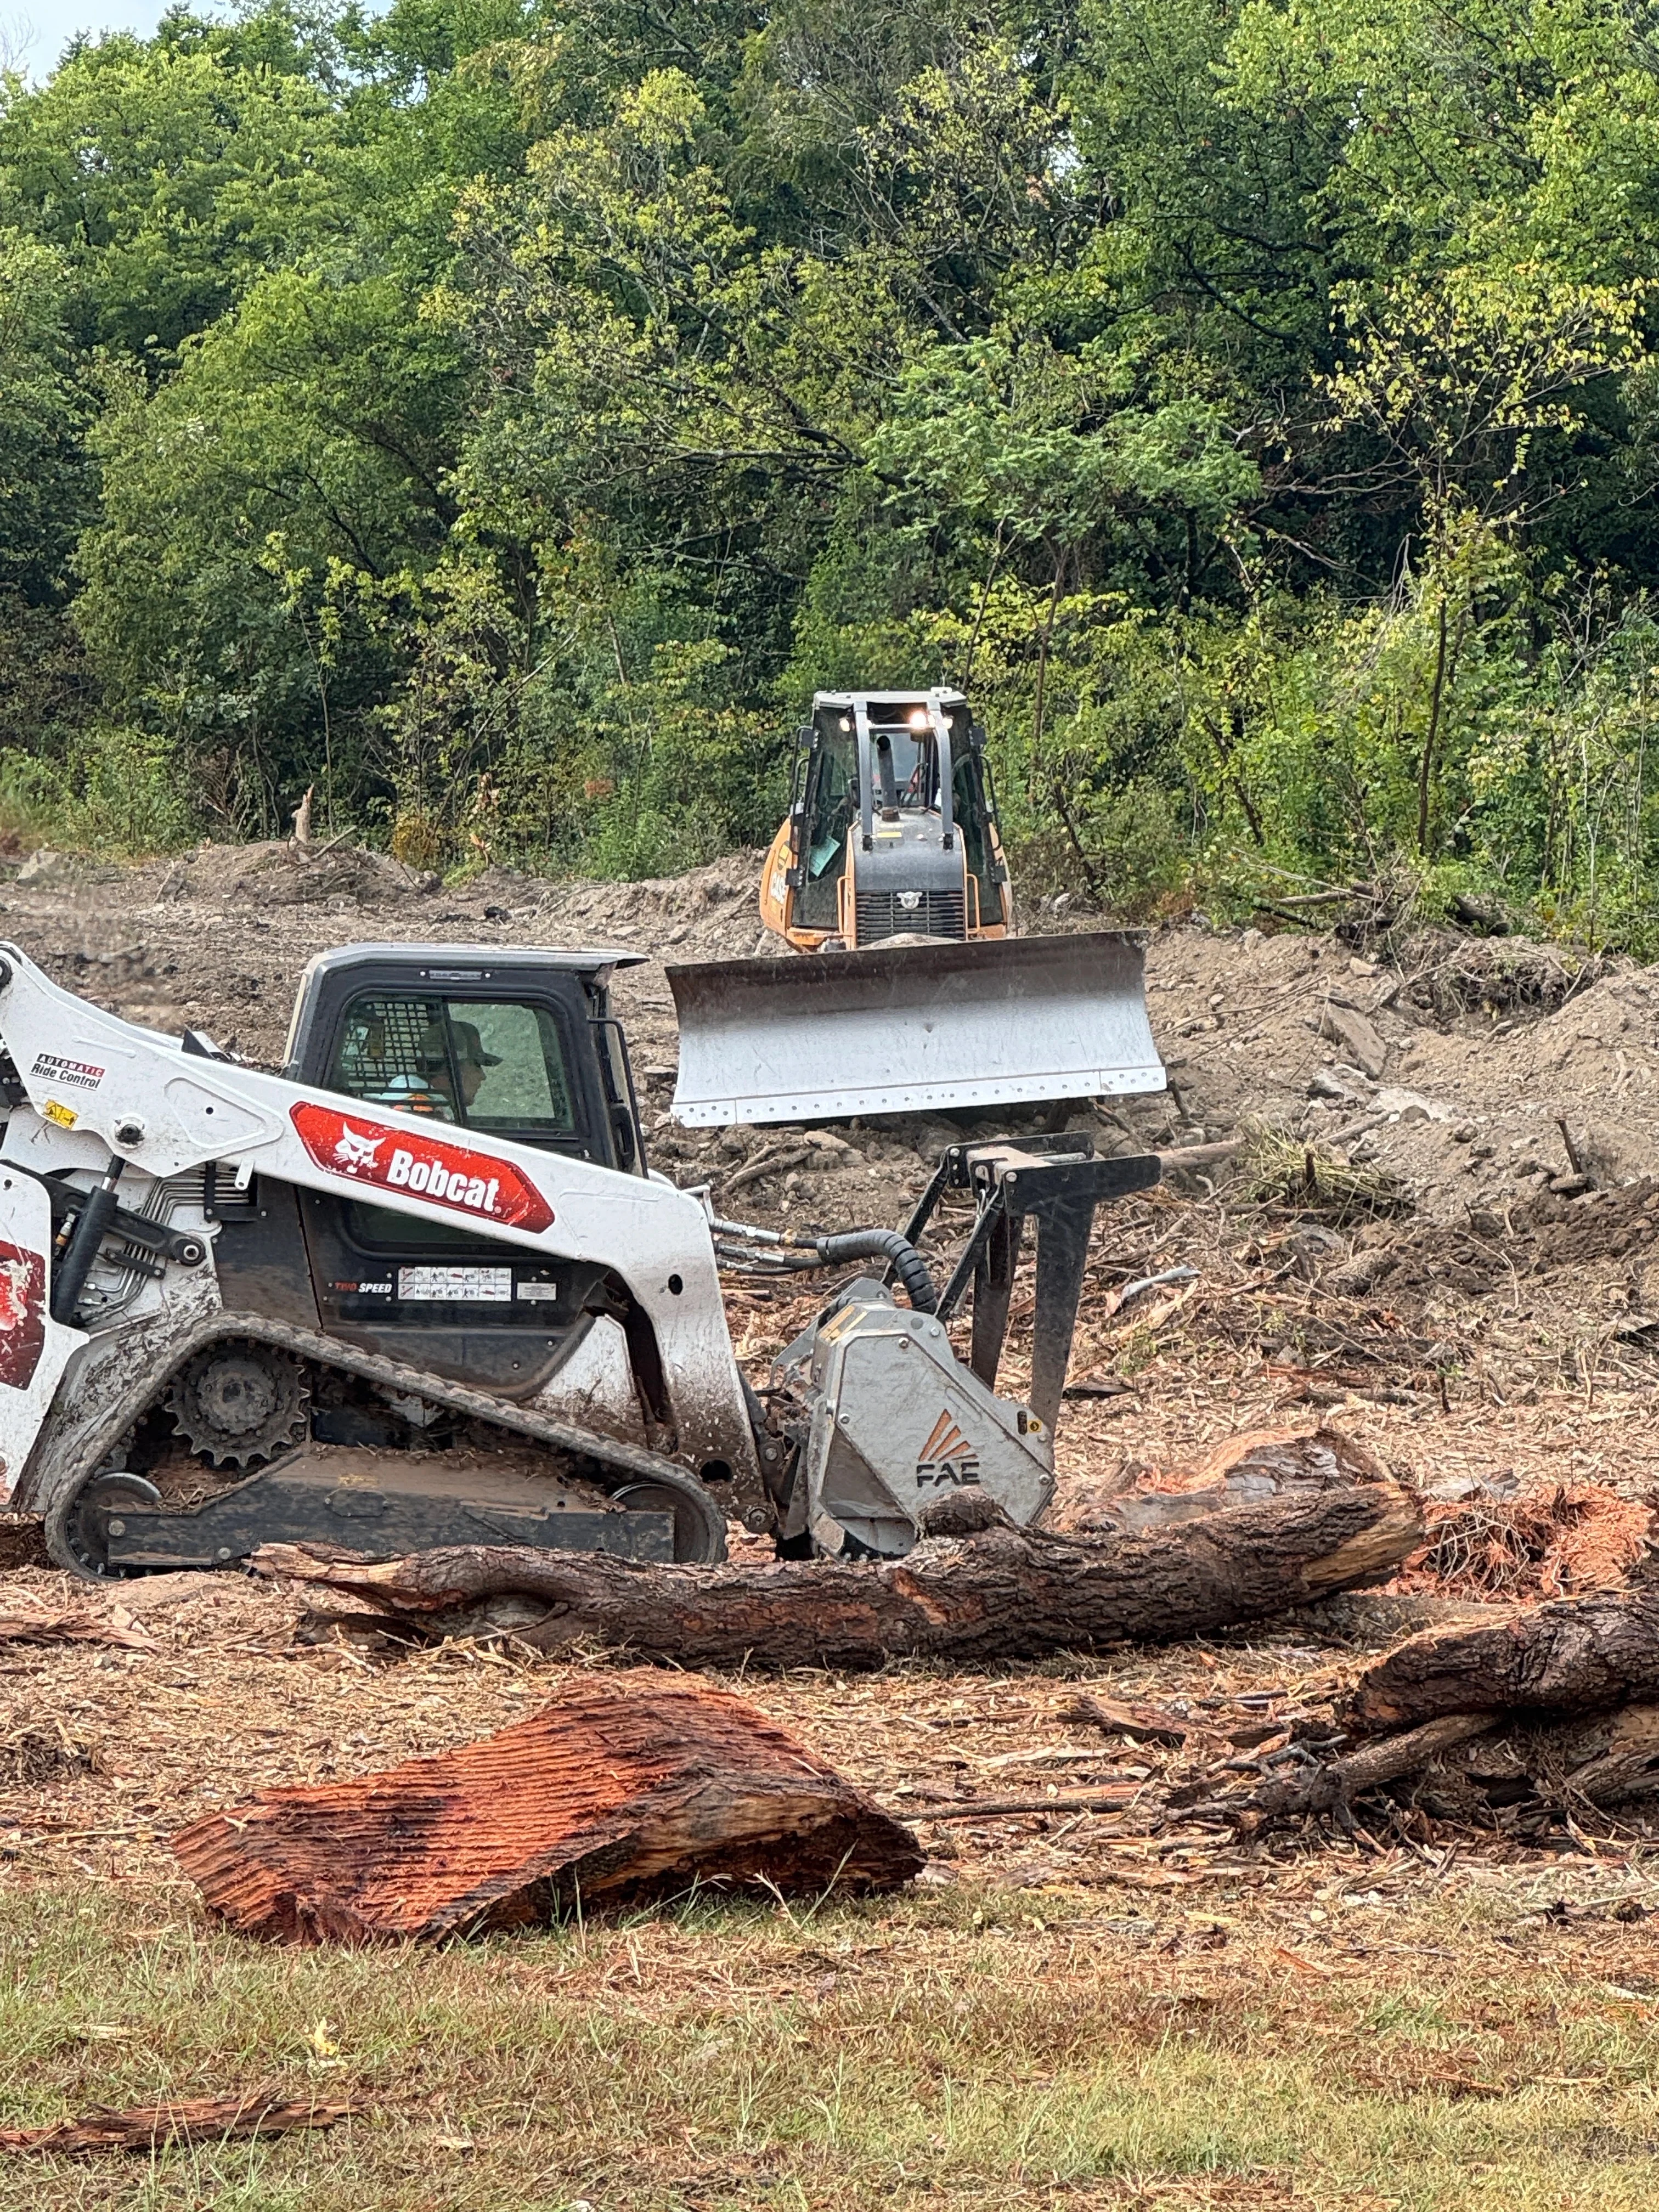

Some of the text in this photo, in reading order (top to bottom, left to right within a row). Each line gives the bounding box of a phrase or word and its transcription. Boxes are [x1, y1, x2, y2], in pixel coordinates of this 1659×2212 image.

[31, 1063, 101, 1088] Ride Control
[40, 1055, 103, 1076] AUTOMATIC
[386, 1148, 500, 1212] Bobcat
[335, 1282, 392, 1293] TWO SPEED
[916, 1462, 980, 1487] FAE
